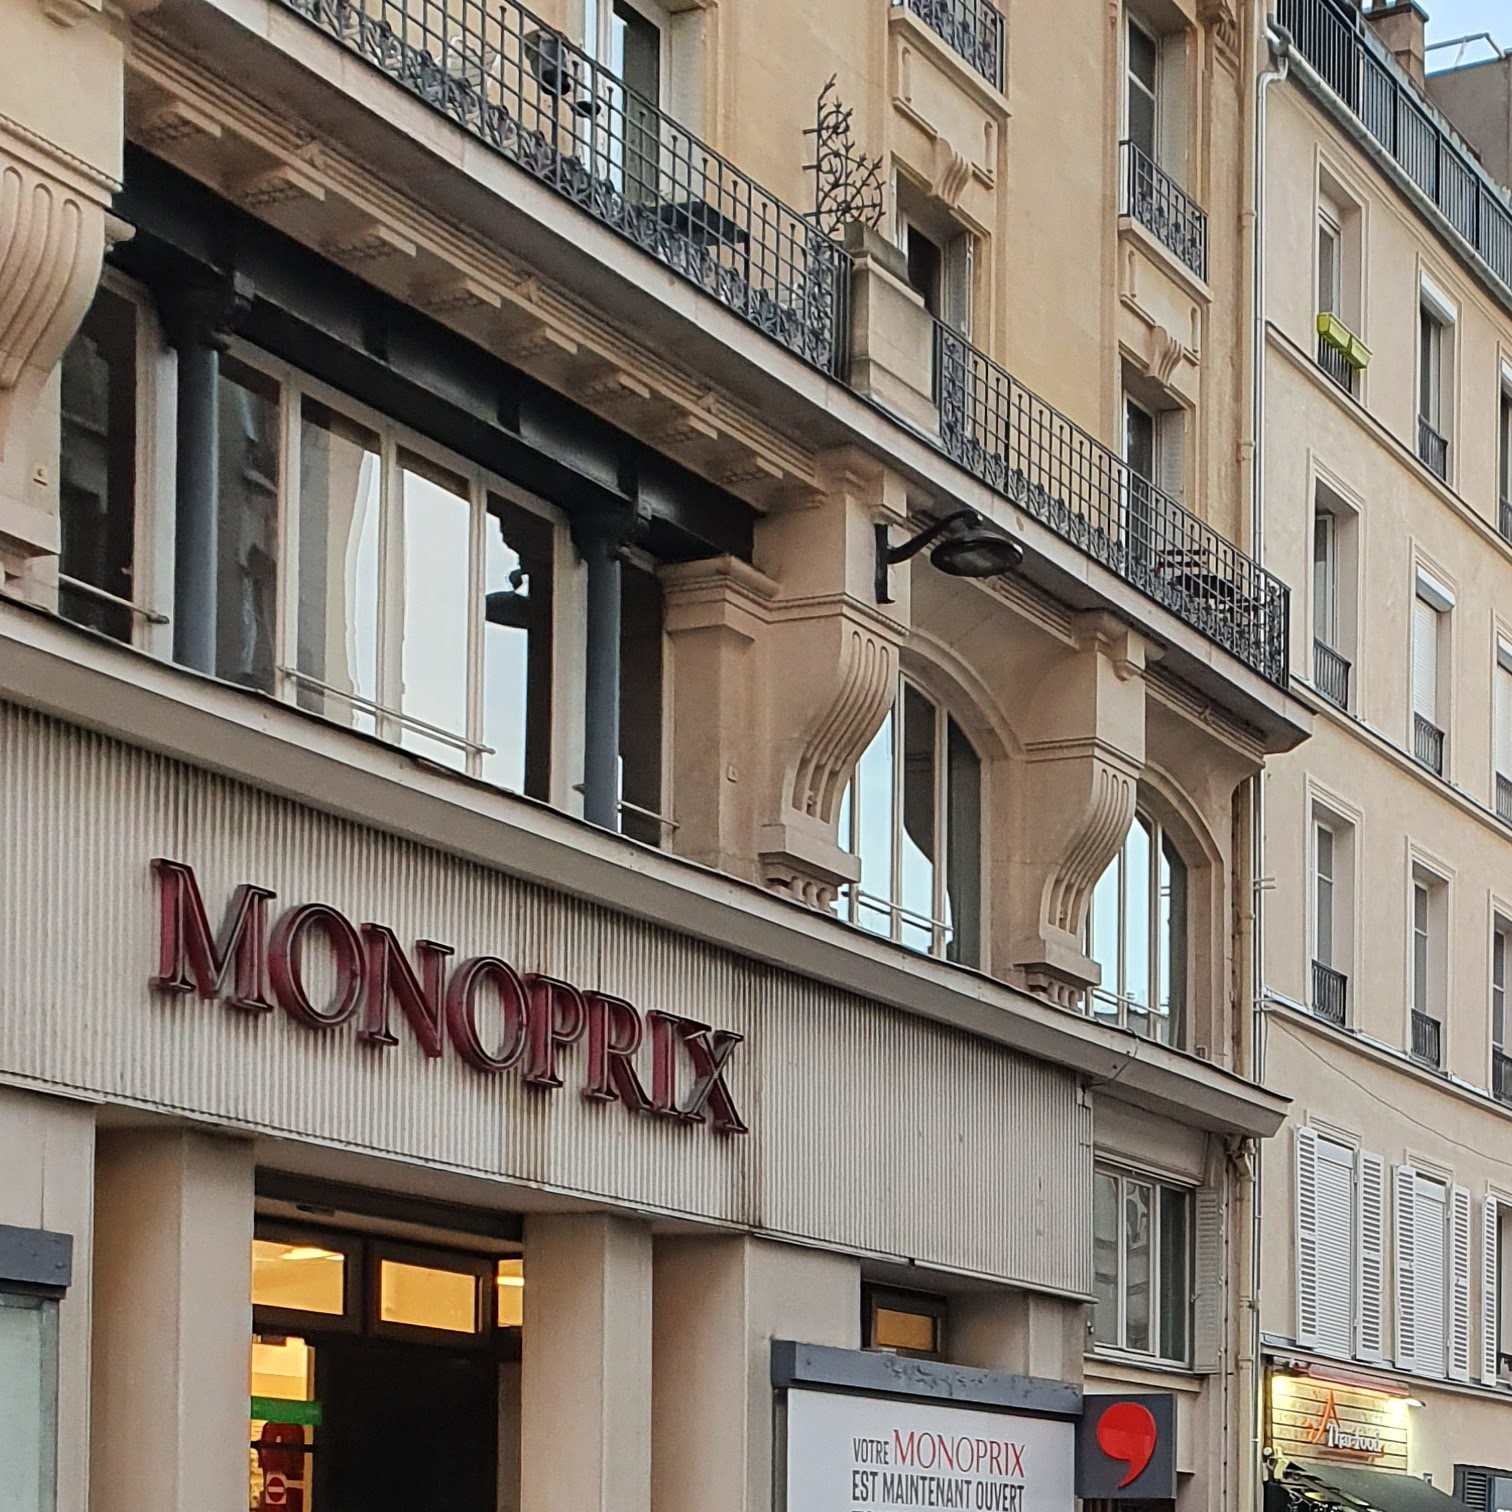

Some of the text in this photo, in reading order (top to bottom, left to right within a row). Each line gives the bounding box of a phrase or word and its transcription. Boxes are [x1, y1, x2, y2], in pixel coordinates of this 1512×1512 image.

[149, 857, 749, 1135] MONOPRIX
[853, 1429, 1025, 1478] VOTRE MONOPRIX
[852, 1470, 1025, 1512] EST MAINTENANT OUVERT
